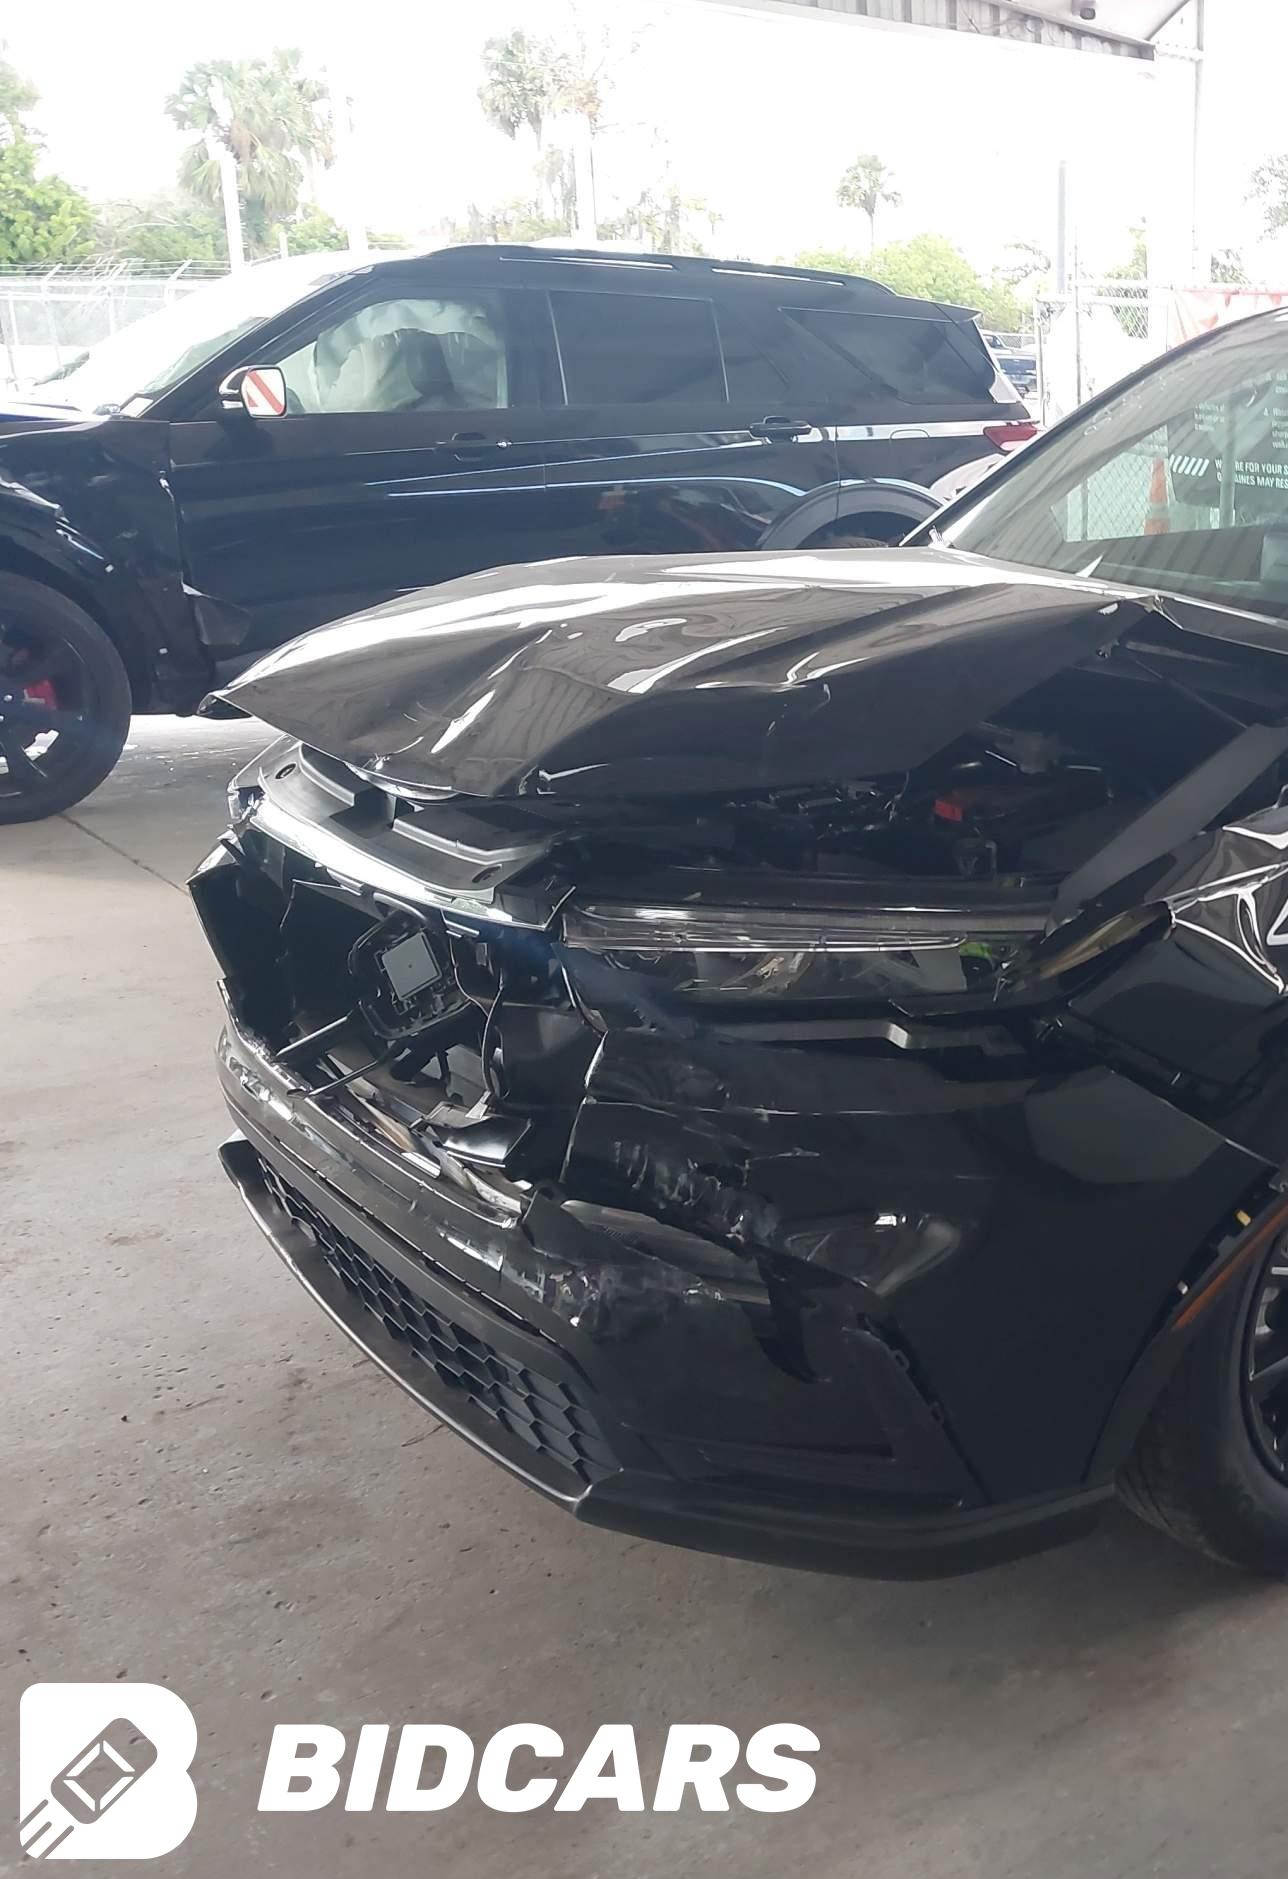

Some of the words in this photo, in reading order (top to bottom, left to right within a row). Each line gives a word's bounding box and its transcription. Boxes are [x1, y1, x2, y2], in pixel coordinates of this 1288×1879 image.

[1245, 461, 1260, 474] FOR
[1261, 462, 1284, 475] YOUR
[1256, 475, 1275, 488] MAY
